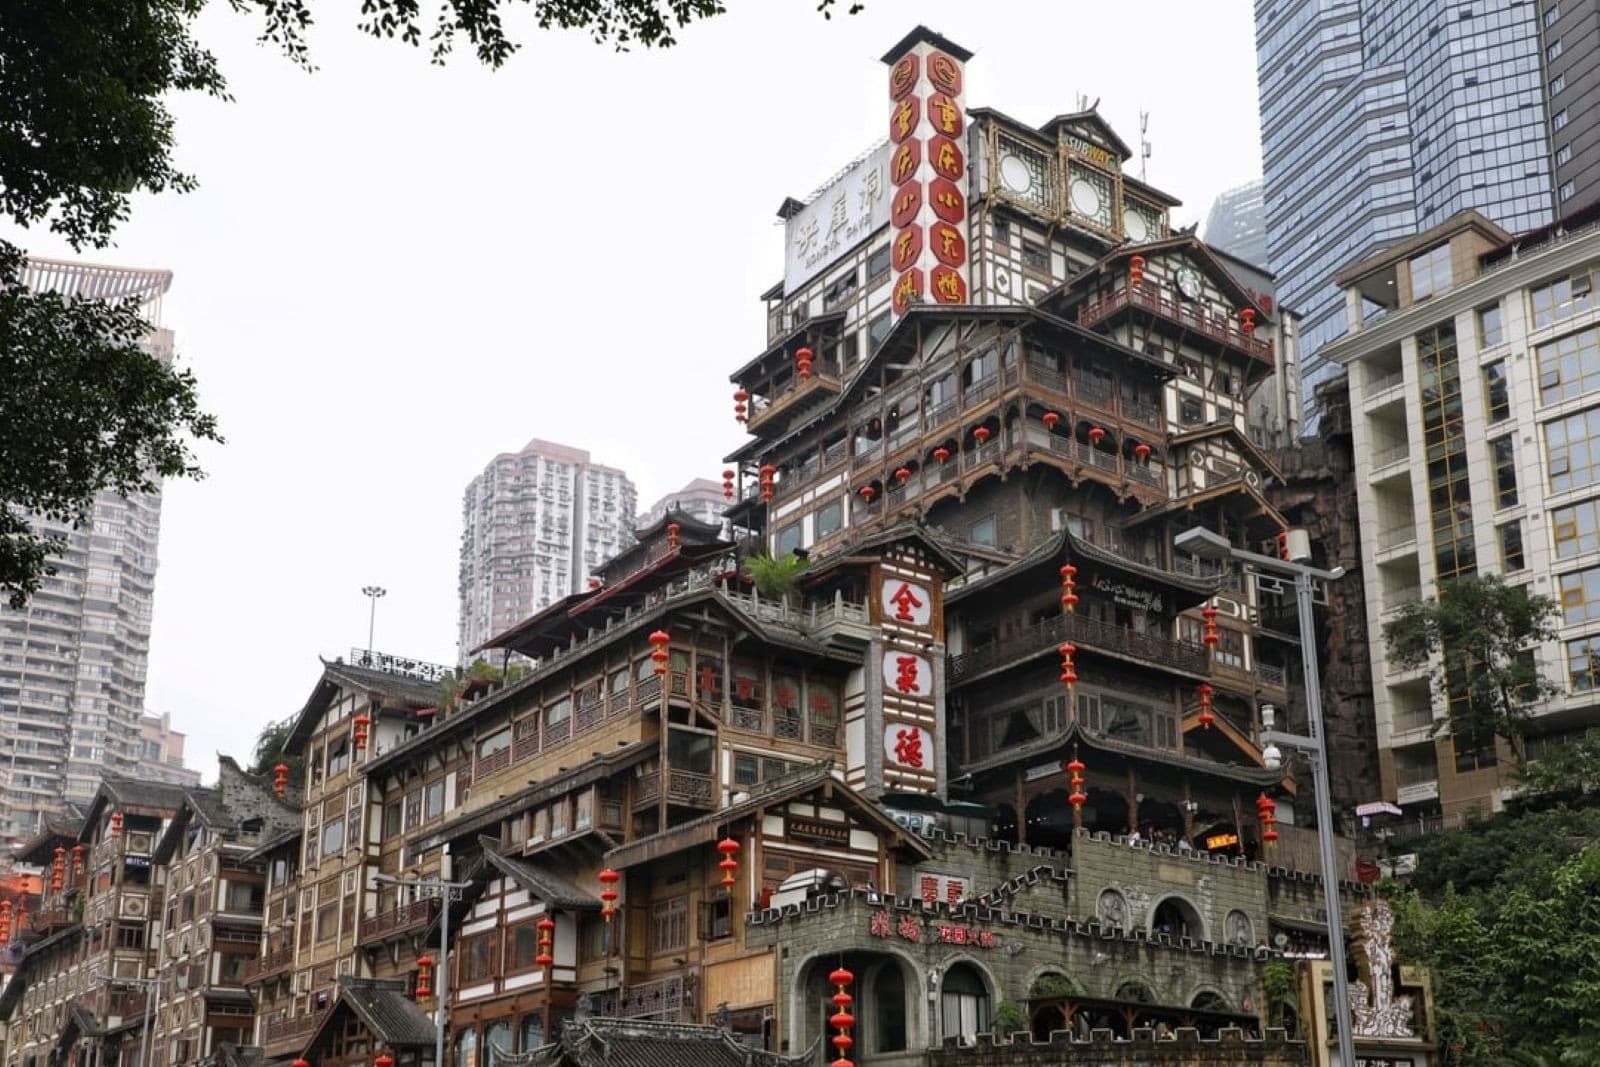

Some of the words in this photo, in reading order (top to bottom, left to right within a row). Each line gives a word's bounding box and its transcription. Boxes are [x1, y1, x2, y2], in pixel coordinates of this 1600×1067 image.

[1065, 136, 1115, 166] SUBWAY
[795, 164, 883, 259] 洪崖洞
[889, 582, 924, 768] 全聚德
